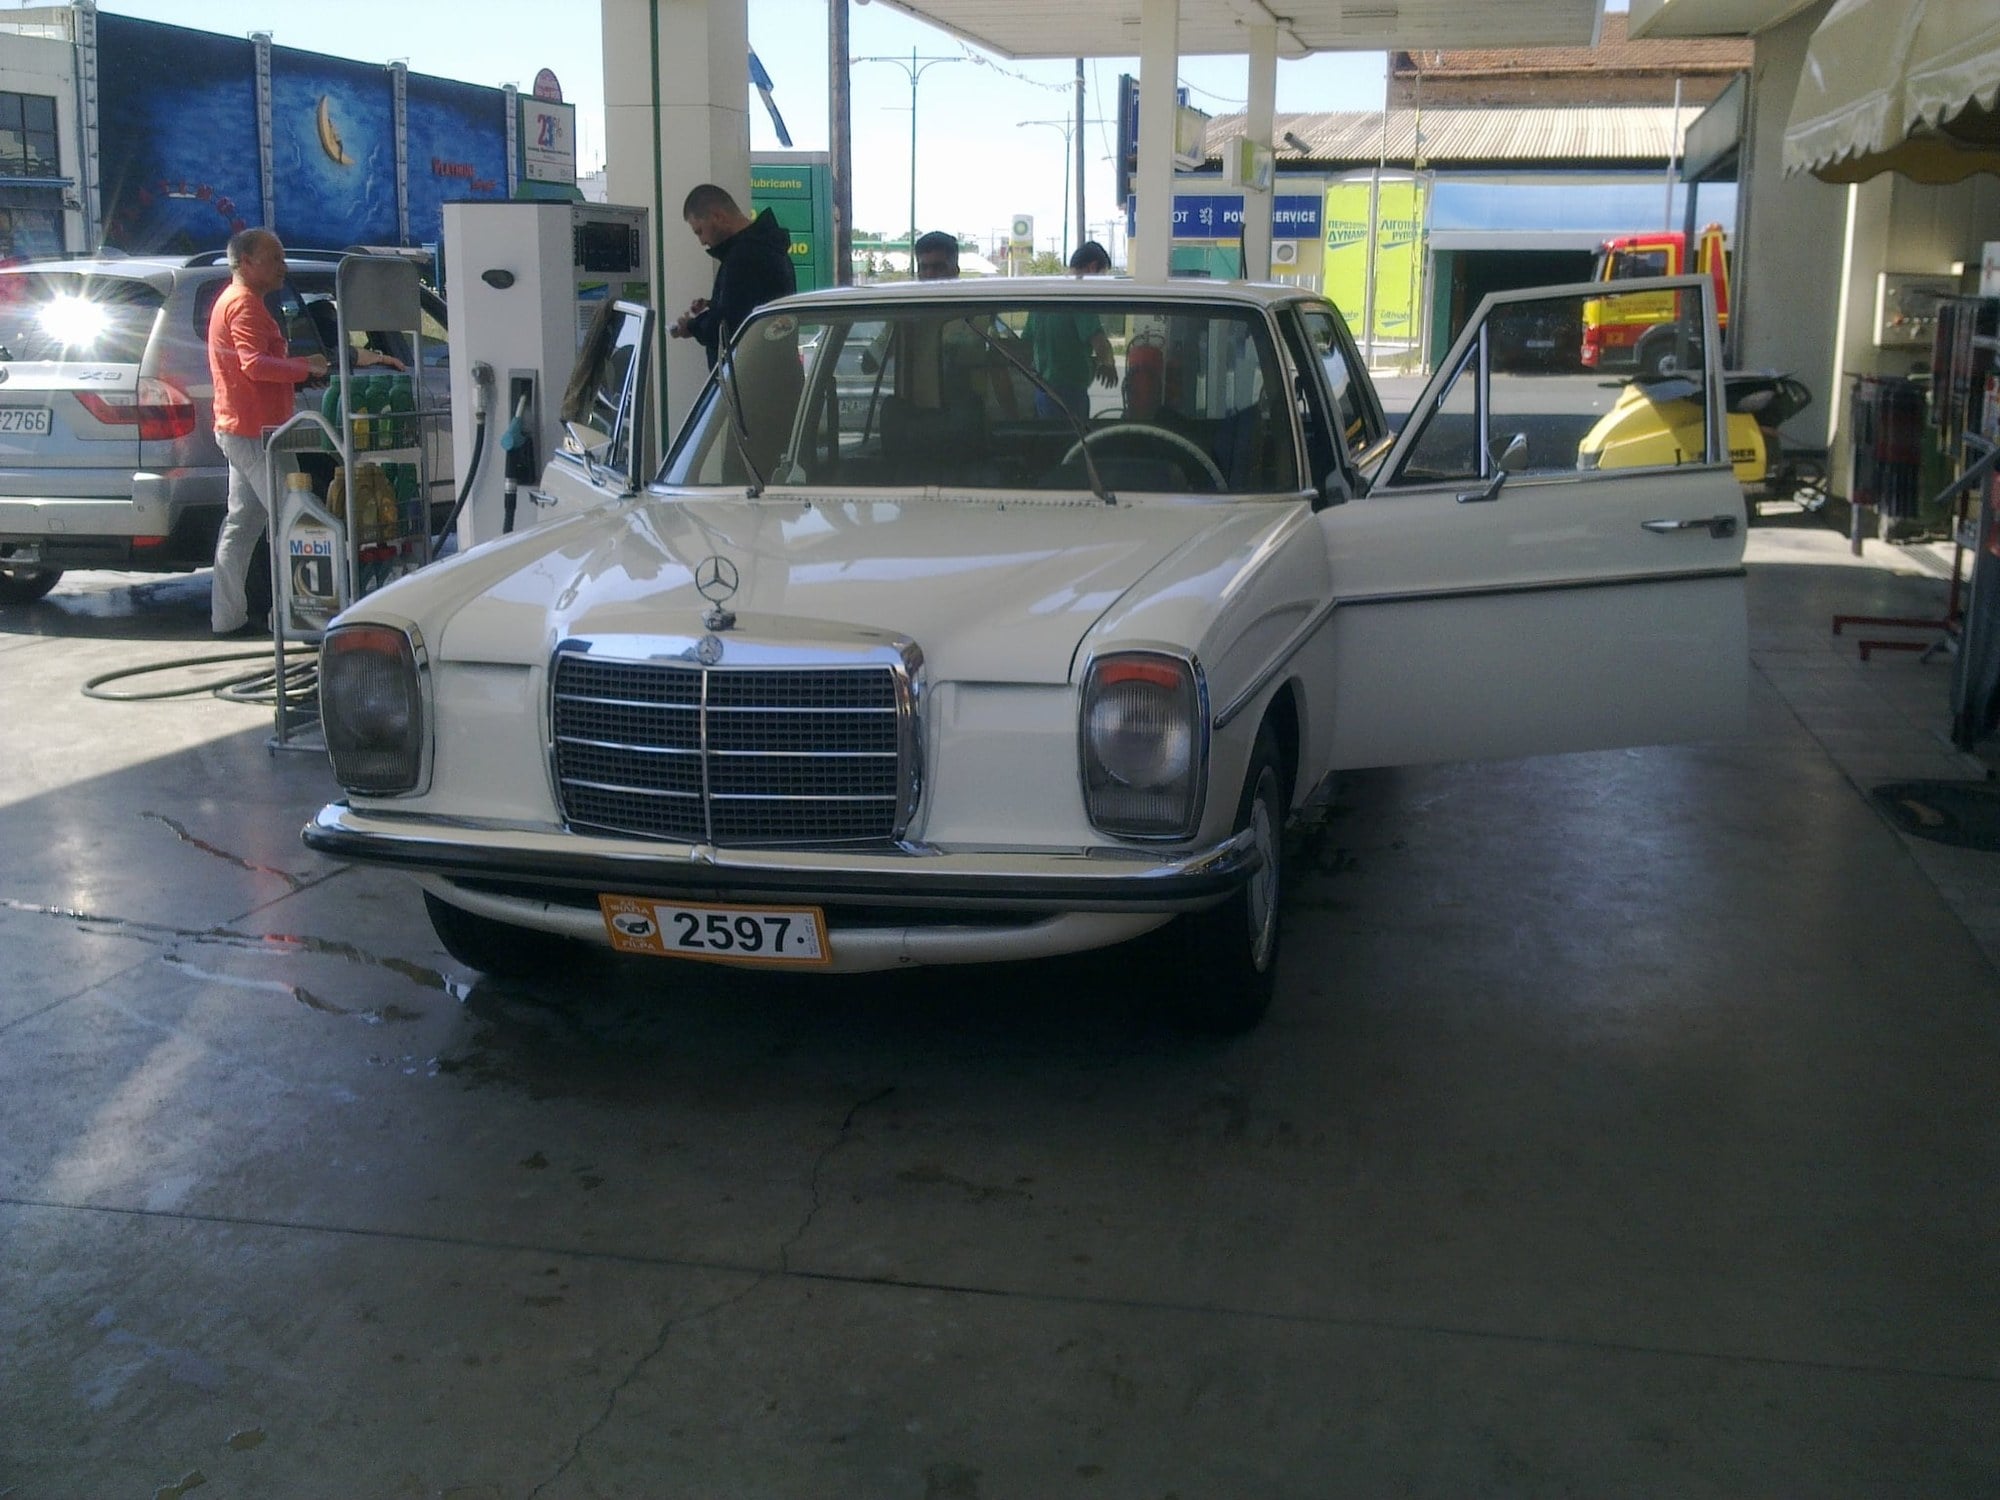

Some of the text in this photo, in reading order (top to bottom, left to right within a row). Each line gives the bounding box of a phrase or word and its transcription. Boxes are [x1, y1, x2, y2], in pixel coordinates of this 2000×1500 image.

[750, 178, 802, 190] lubricants
[0, 411, 46, 430] 2766
[289, 540, 331, 555] Mobil
[305, 560, 319, 592] 1
[673, 912, 791, 953] 2597
